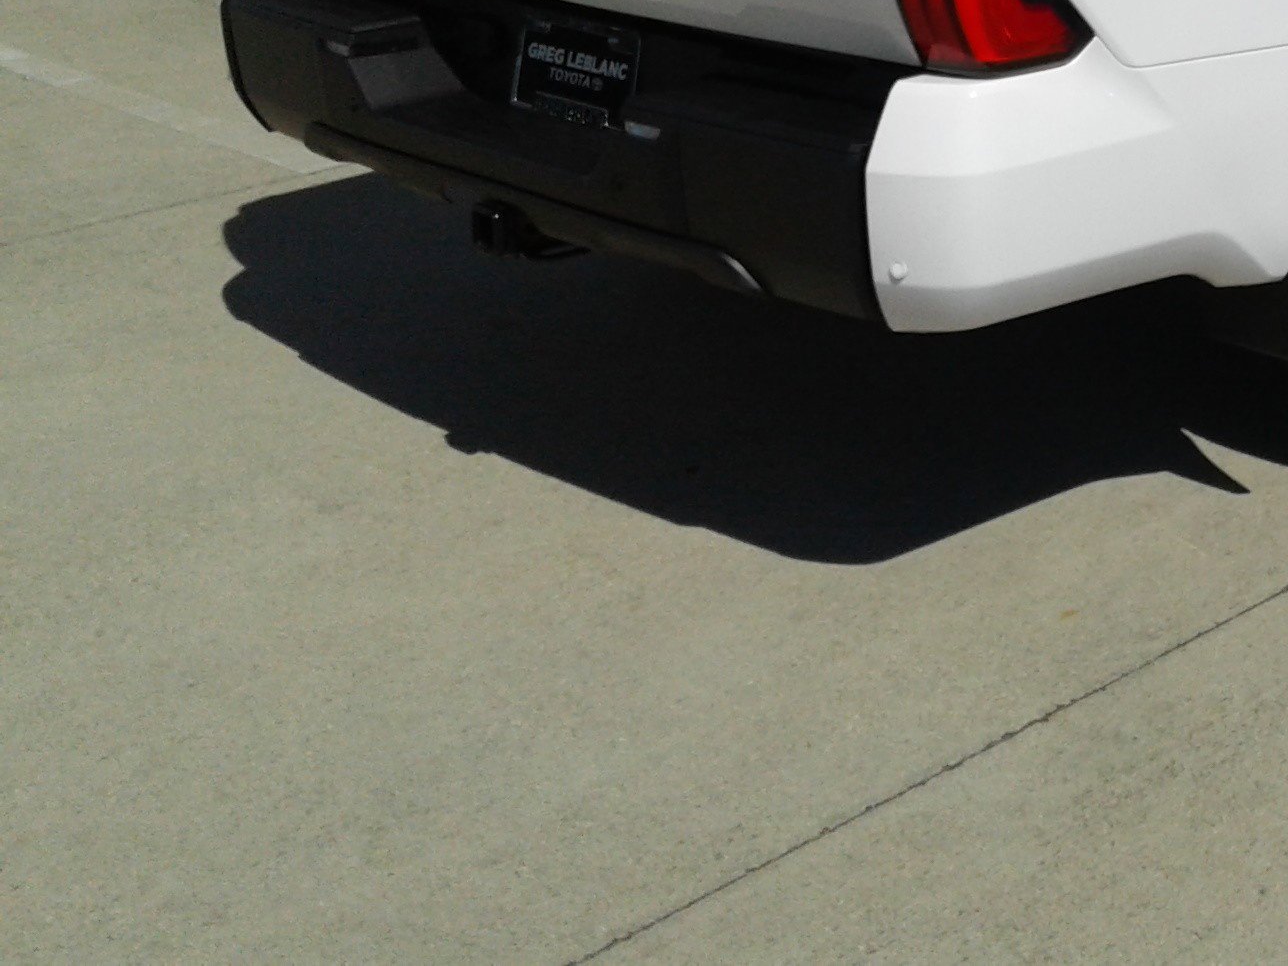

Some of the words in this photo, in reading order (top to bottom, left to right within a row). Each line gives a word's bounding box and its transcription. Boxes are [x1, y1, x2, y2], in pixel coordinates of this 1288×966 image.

[527, 42, 566, 67] GREG
[566, 51, 629, 81] LEBLANC
[549, 66, 591, 89] TOYOTA
